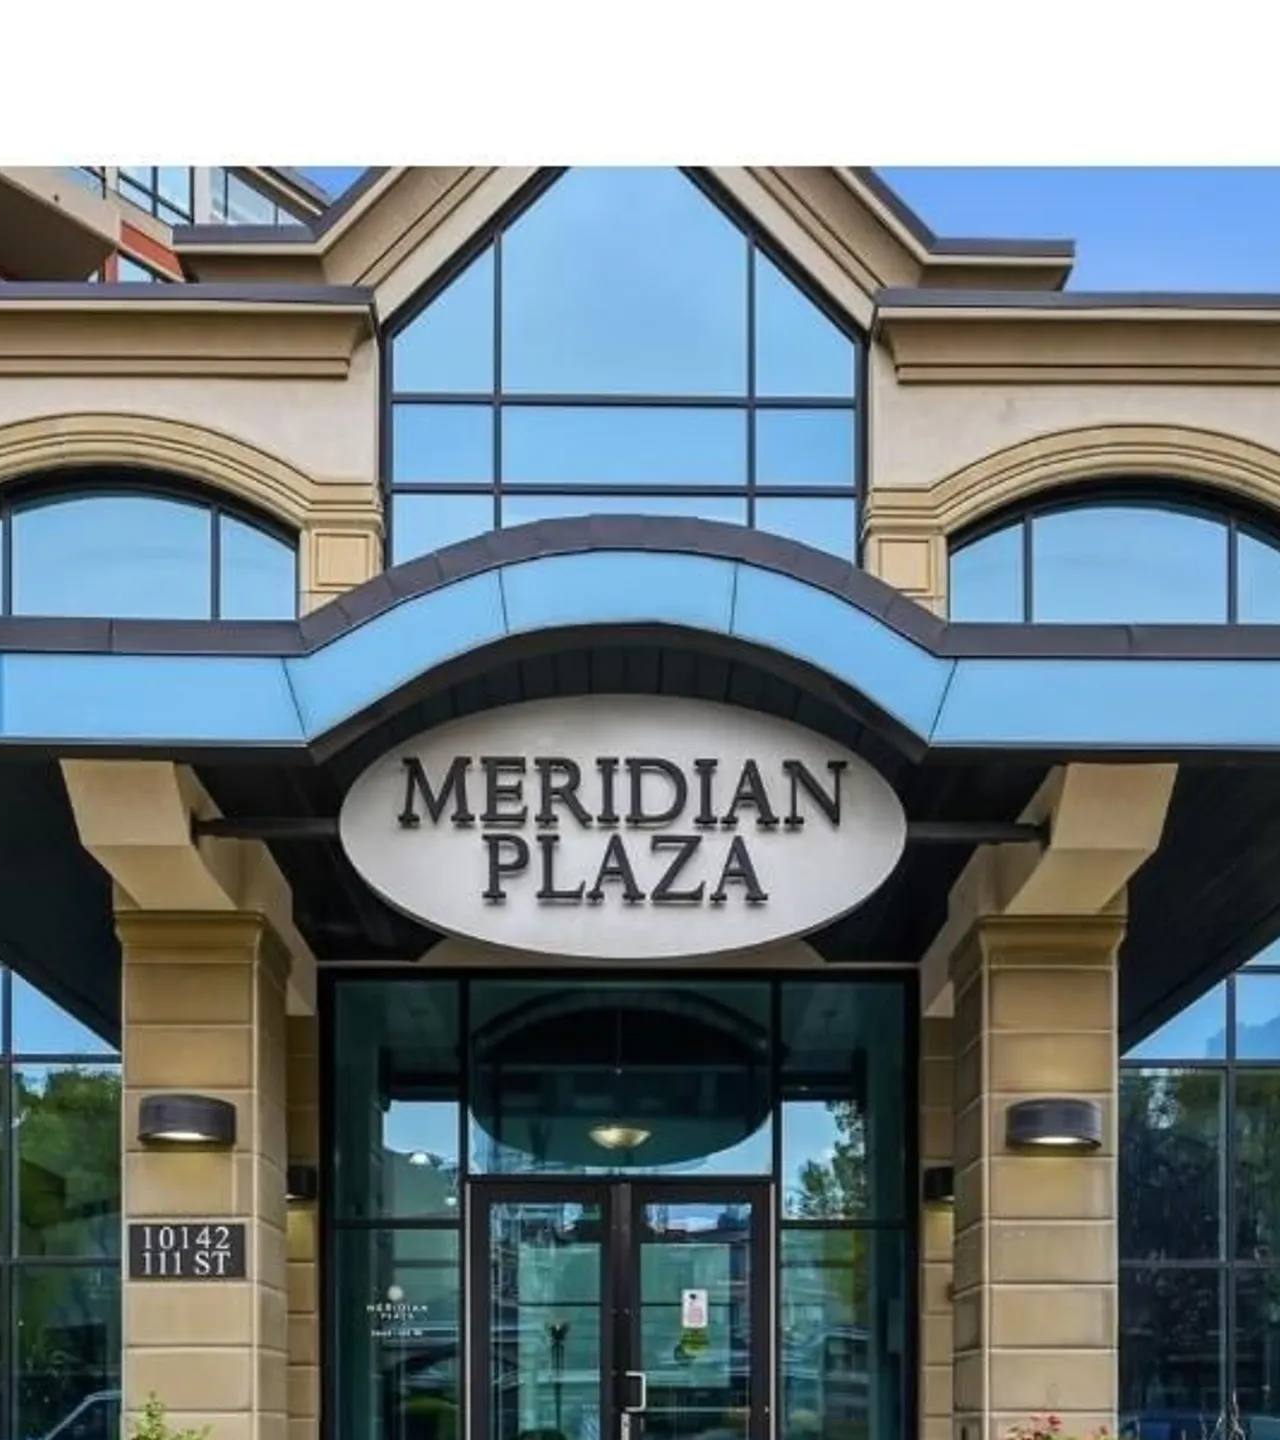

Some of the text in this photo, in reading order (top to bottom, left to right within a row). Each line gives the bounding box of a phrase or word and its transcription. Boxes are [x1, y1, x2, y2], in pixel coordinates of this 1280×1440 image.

[397, 756, 848, 828] MERIDIAN
[481, 834, 769, 903] PLAZA
[143, 1226, 231, 1250] 10142
[141, 1250, 231, 1275] 111 ST
